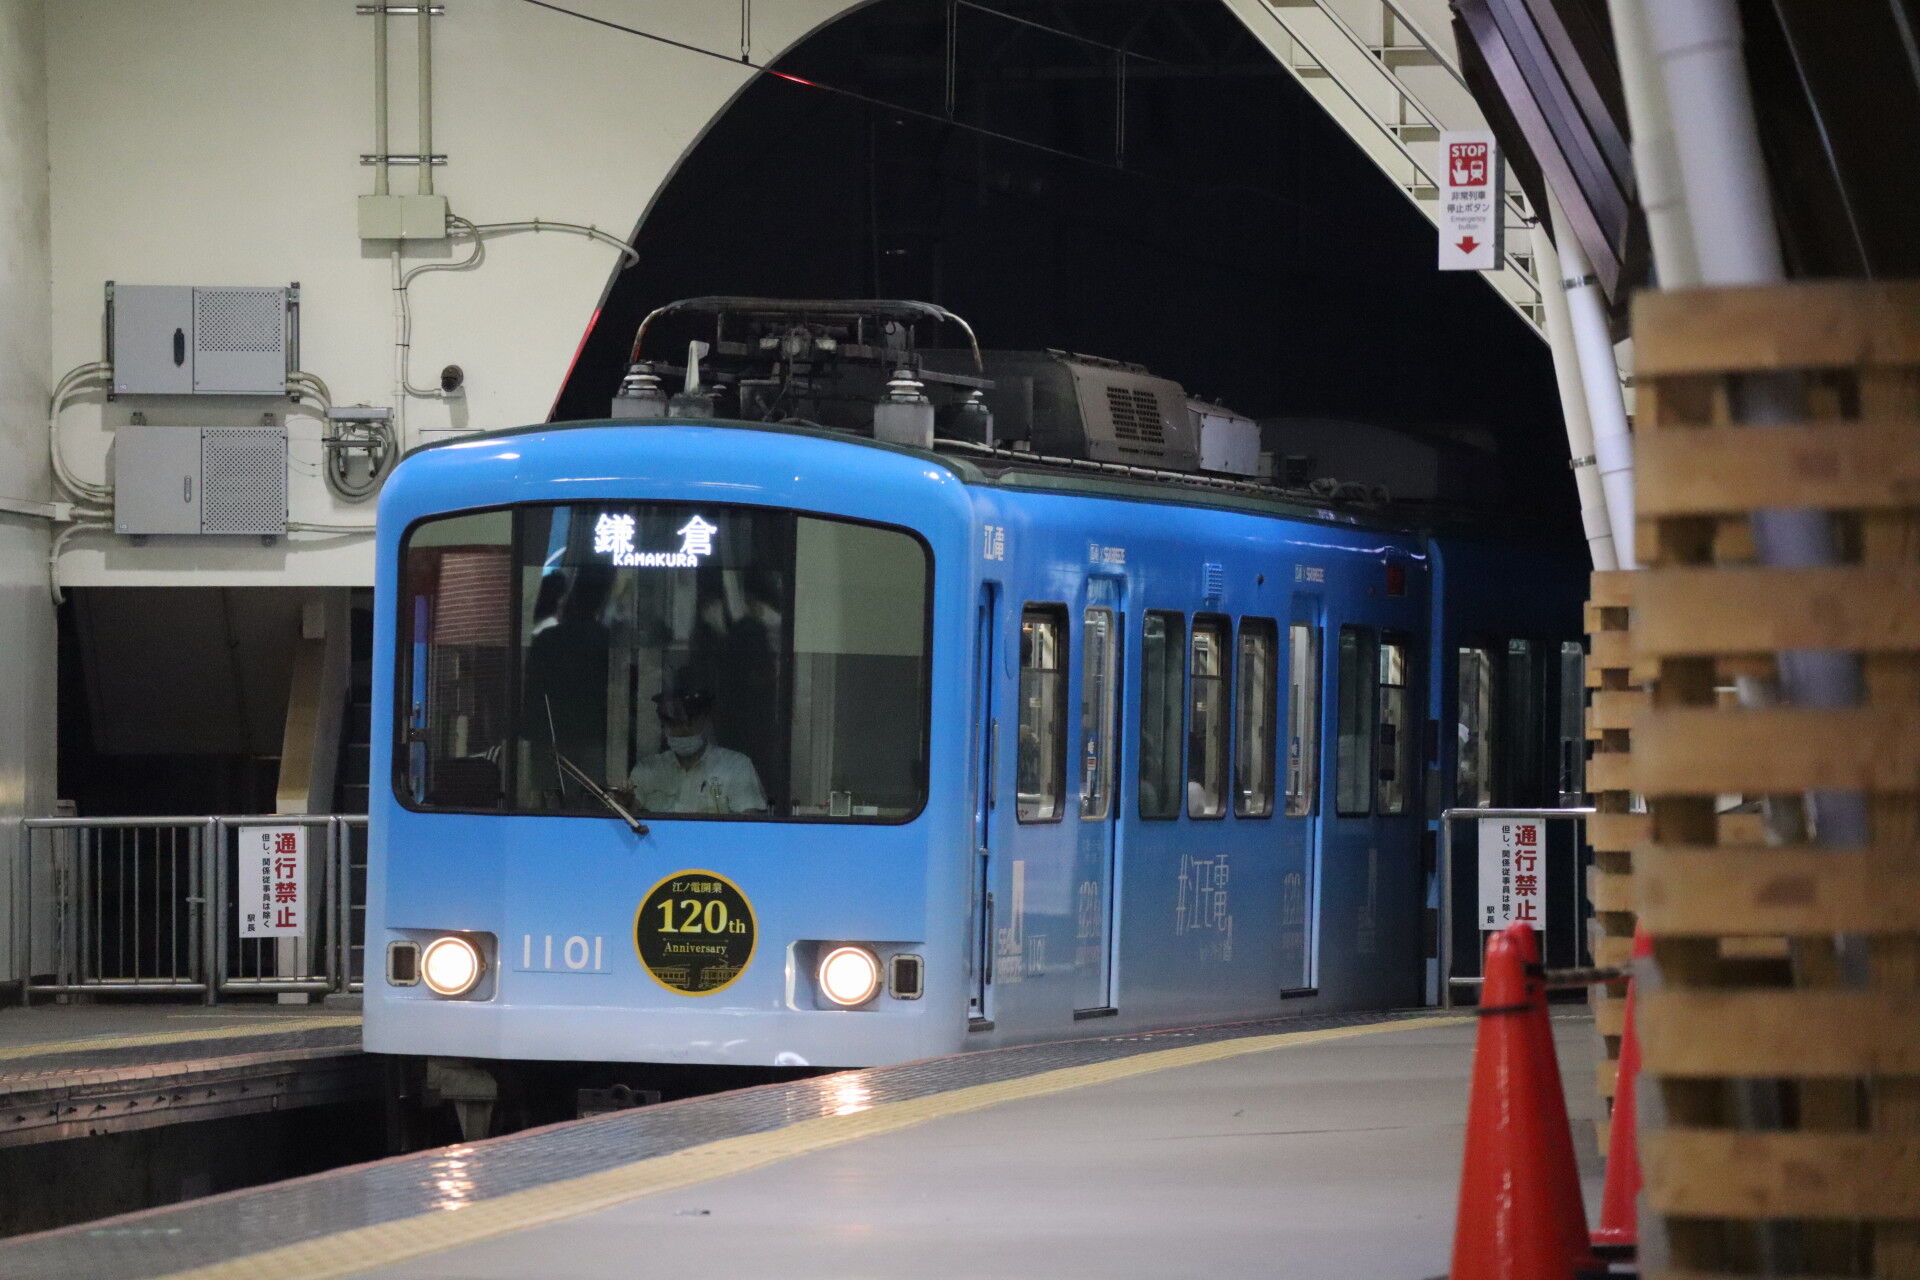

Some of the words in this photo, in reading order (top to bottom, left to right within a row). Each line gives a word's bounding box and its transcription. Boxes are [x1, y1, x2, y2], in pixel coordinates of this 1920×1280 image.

[1451, 145, 1486, 157] STOP
[1451, 191, 1486, 201] 非常列車
[1447, 203, 1490, 214] 停止ボタン
[594, 513, 718, 555] 鎌倉
[613, 552, 698, 567] KAMAKURA
[261, 833, 271, 928] 但し、関係従事員は除く
[275, 833, 297, 928] 通行禁止
[1501, 825, 1511, 921] 但し、関係従事員は除く
[1515, 825, 1537, 921] 通行禁止
[672, 882, 723, 894] 江ノ電開業
[247, 913, 256, 932] 駅長
[1486, 905, 1495, 924] 駅長
[523, 934, 602, 970] 1101
[664, 941, 727, 955] Anniversary
